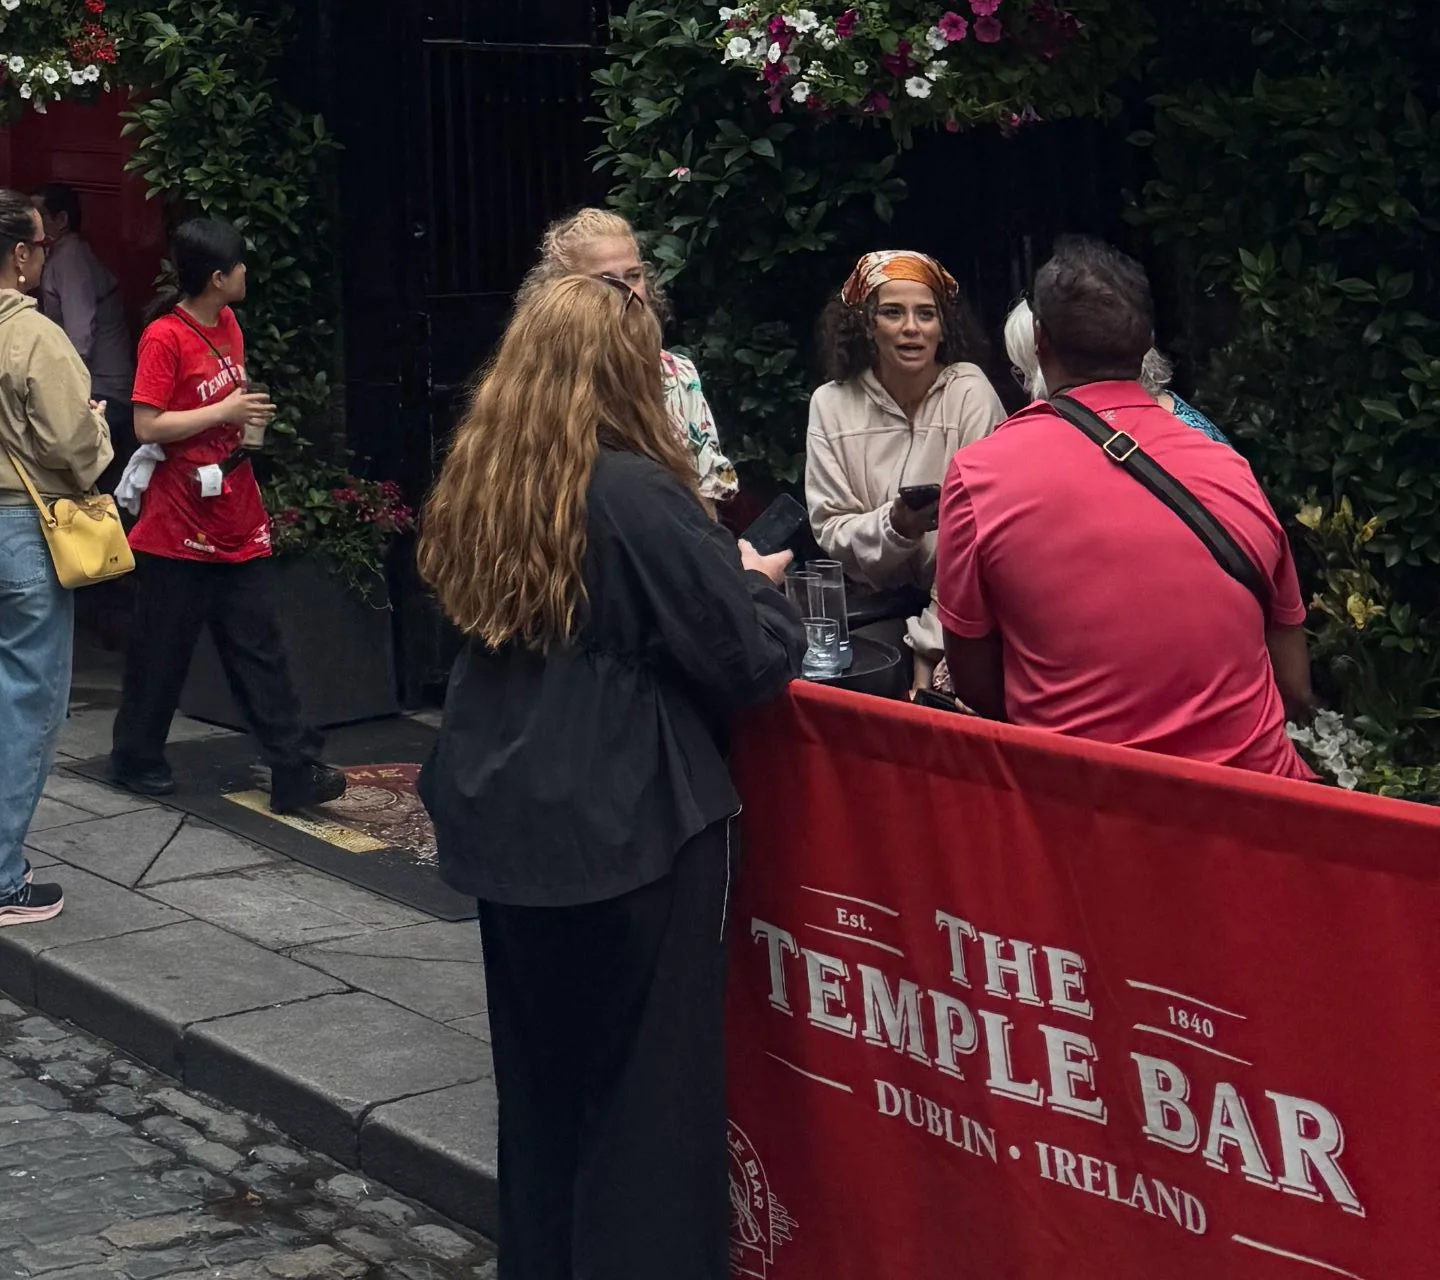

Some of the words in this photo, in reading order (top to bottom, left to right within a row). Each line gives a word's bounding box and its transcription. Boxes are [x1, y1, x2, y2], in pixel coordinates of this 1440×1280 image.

[835, 907, 873, 932] Est.
[935, 908, 1094, 1021] THE
[1167, 1004, 1214, 1038] 1840
[750, 916, 1108, 1125] TEMPLE
[1129, 1050, 1366, 1218] BAR
[744, 1159, 764, 1210] BAR
[874, 1077, 997, 1166] DUBLIN
[1034, 1140, 1208, 1237] IRELAND
